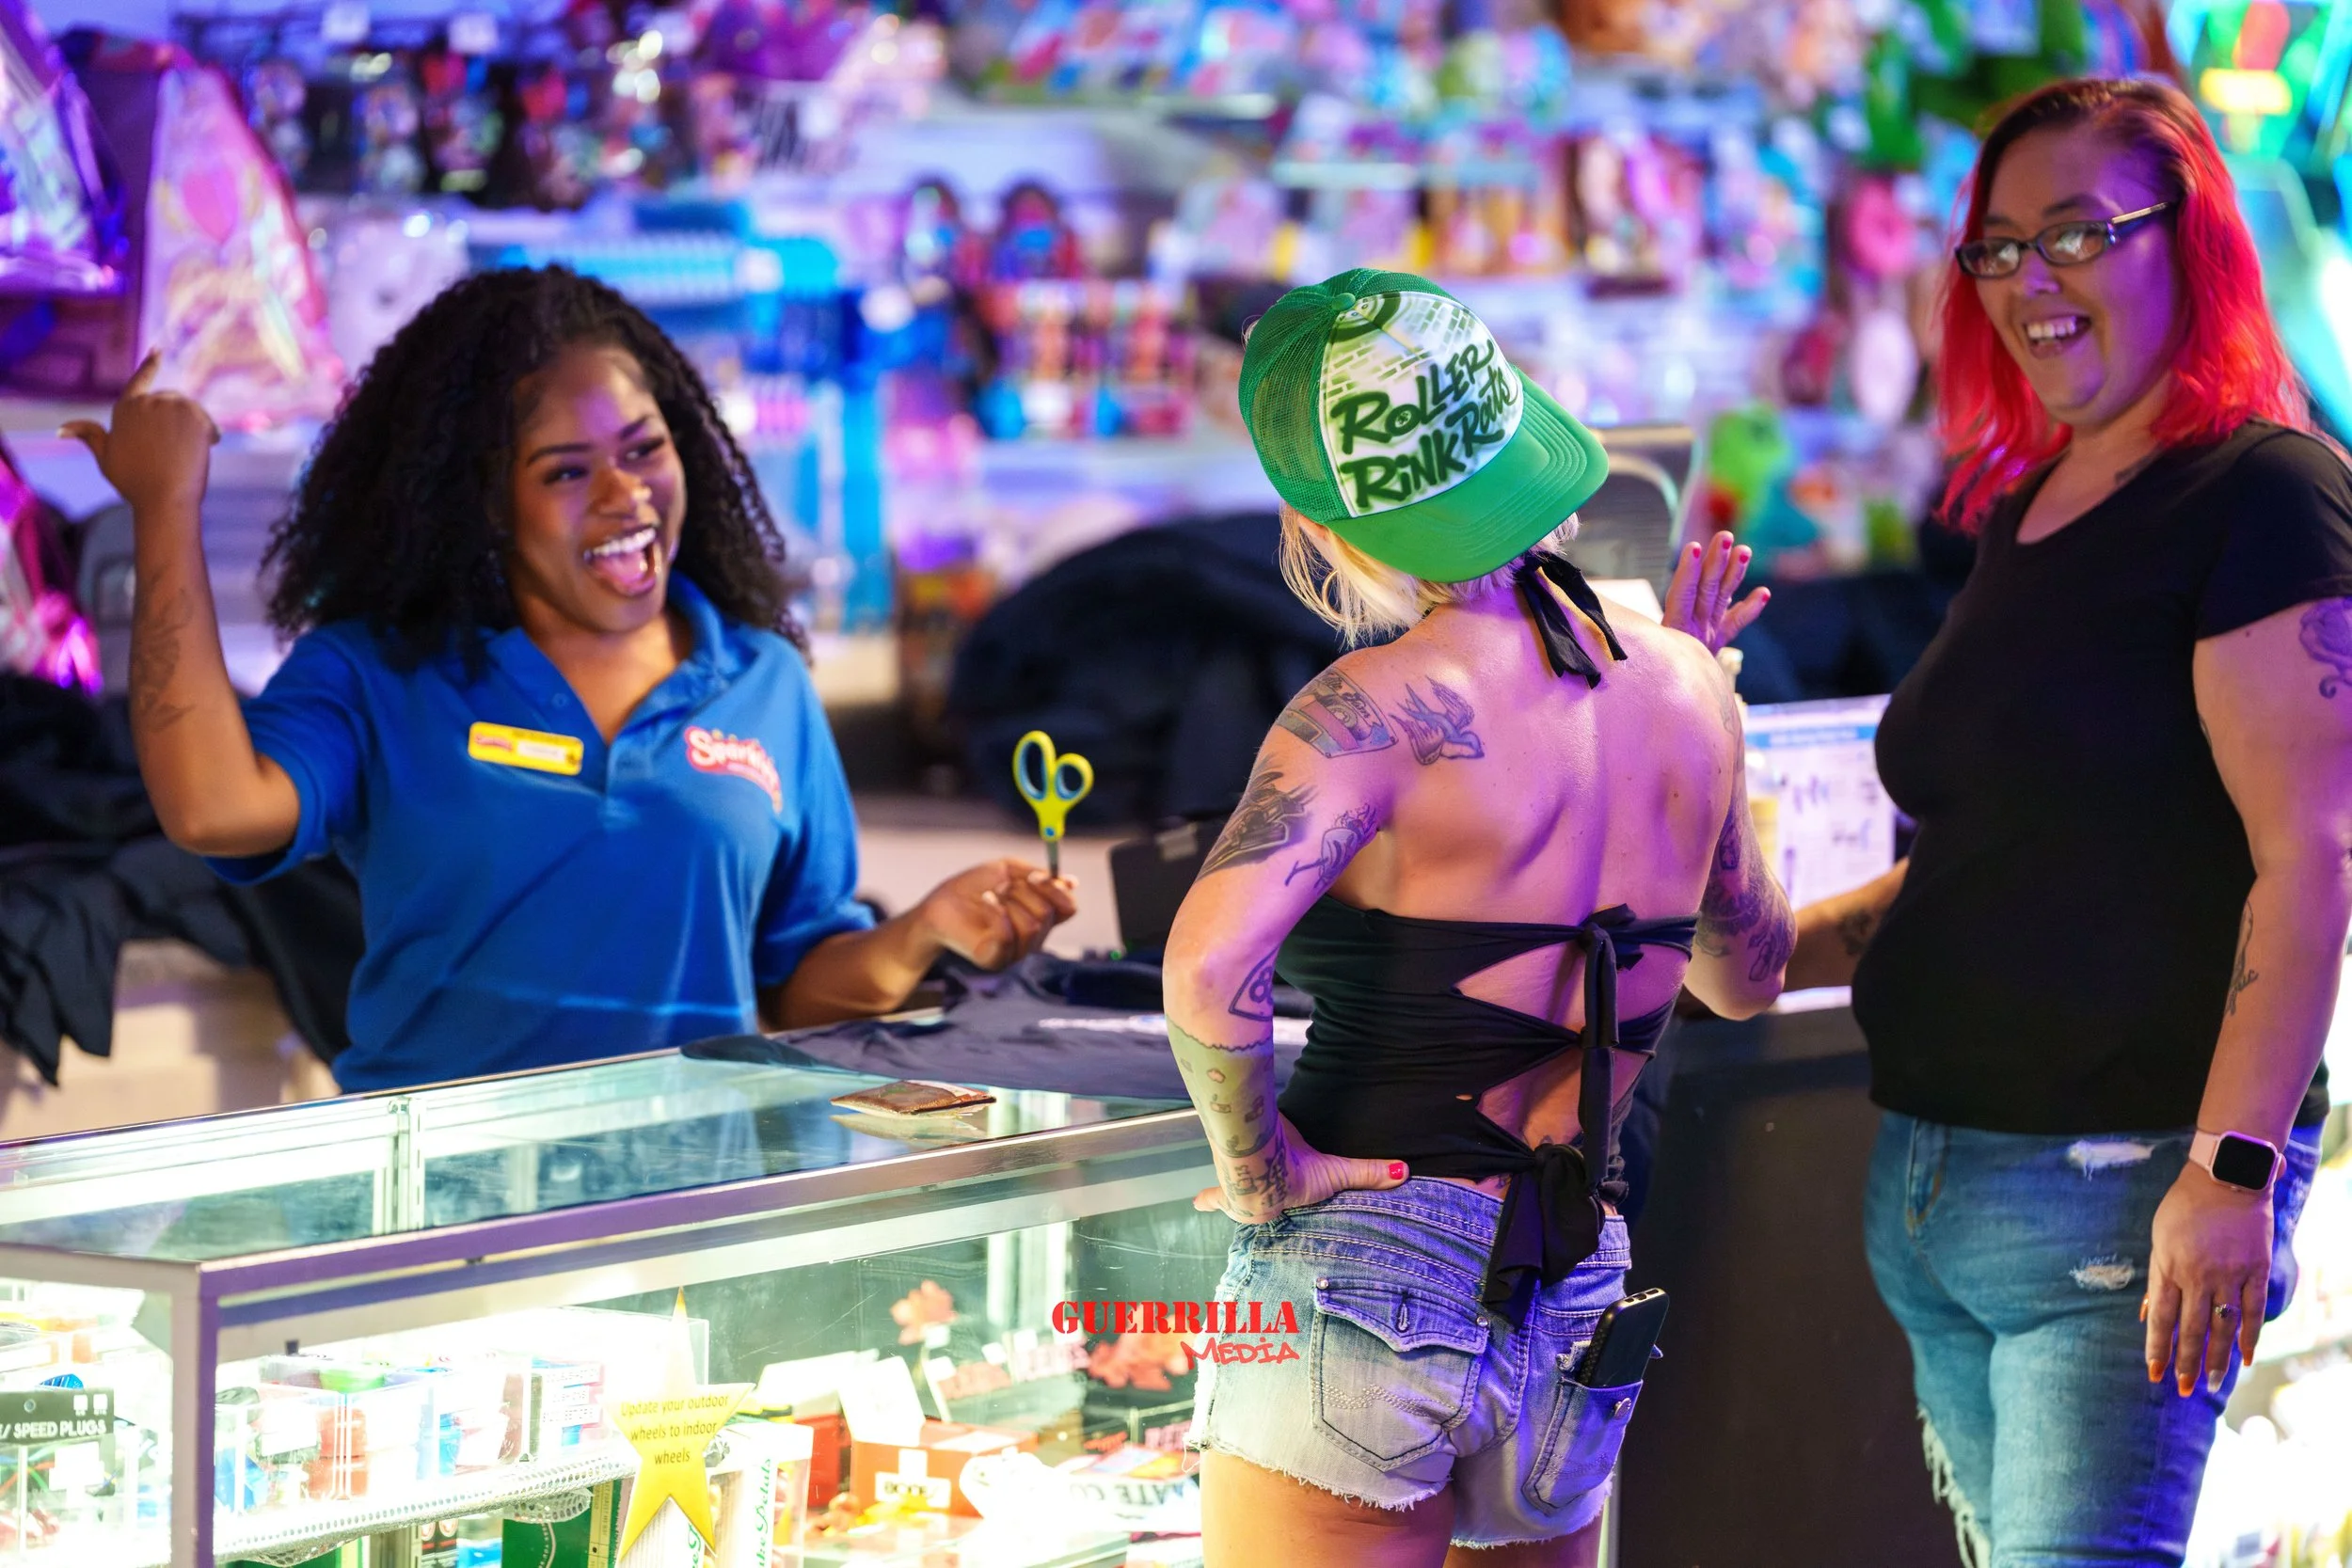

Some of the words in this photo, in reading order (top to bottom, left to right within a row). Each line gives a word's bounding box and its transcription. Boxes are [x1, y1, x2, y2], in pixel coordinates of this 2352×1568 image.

[622, 1401, 659, 1417] Update
[661, 1400, 684, 1414] your
[688, 1394, 729, 1410] outdoor
[13, 1420, 58, 1439] SPEED
[59, 1418, 107, 1437] PLUGS
[631, 1425, 666, 1441] wheels
[670, 1424, 680, 1437] to
[683, 1419, 717, 1436] indoor
[654, 1447, 691, 1465] wheels
